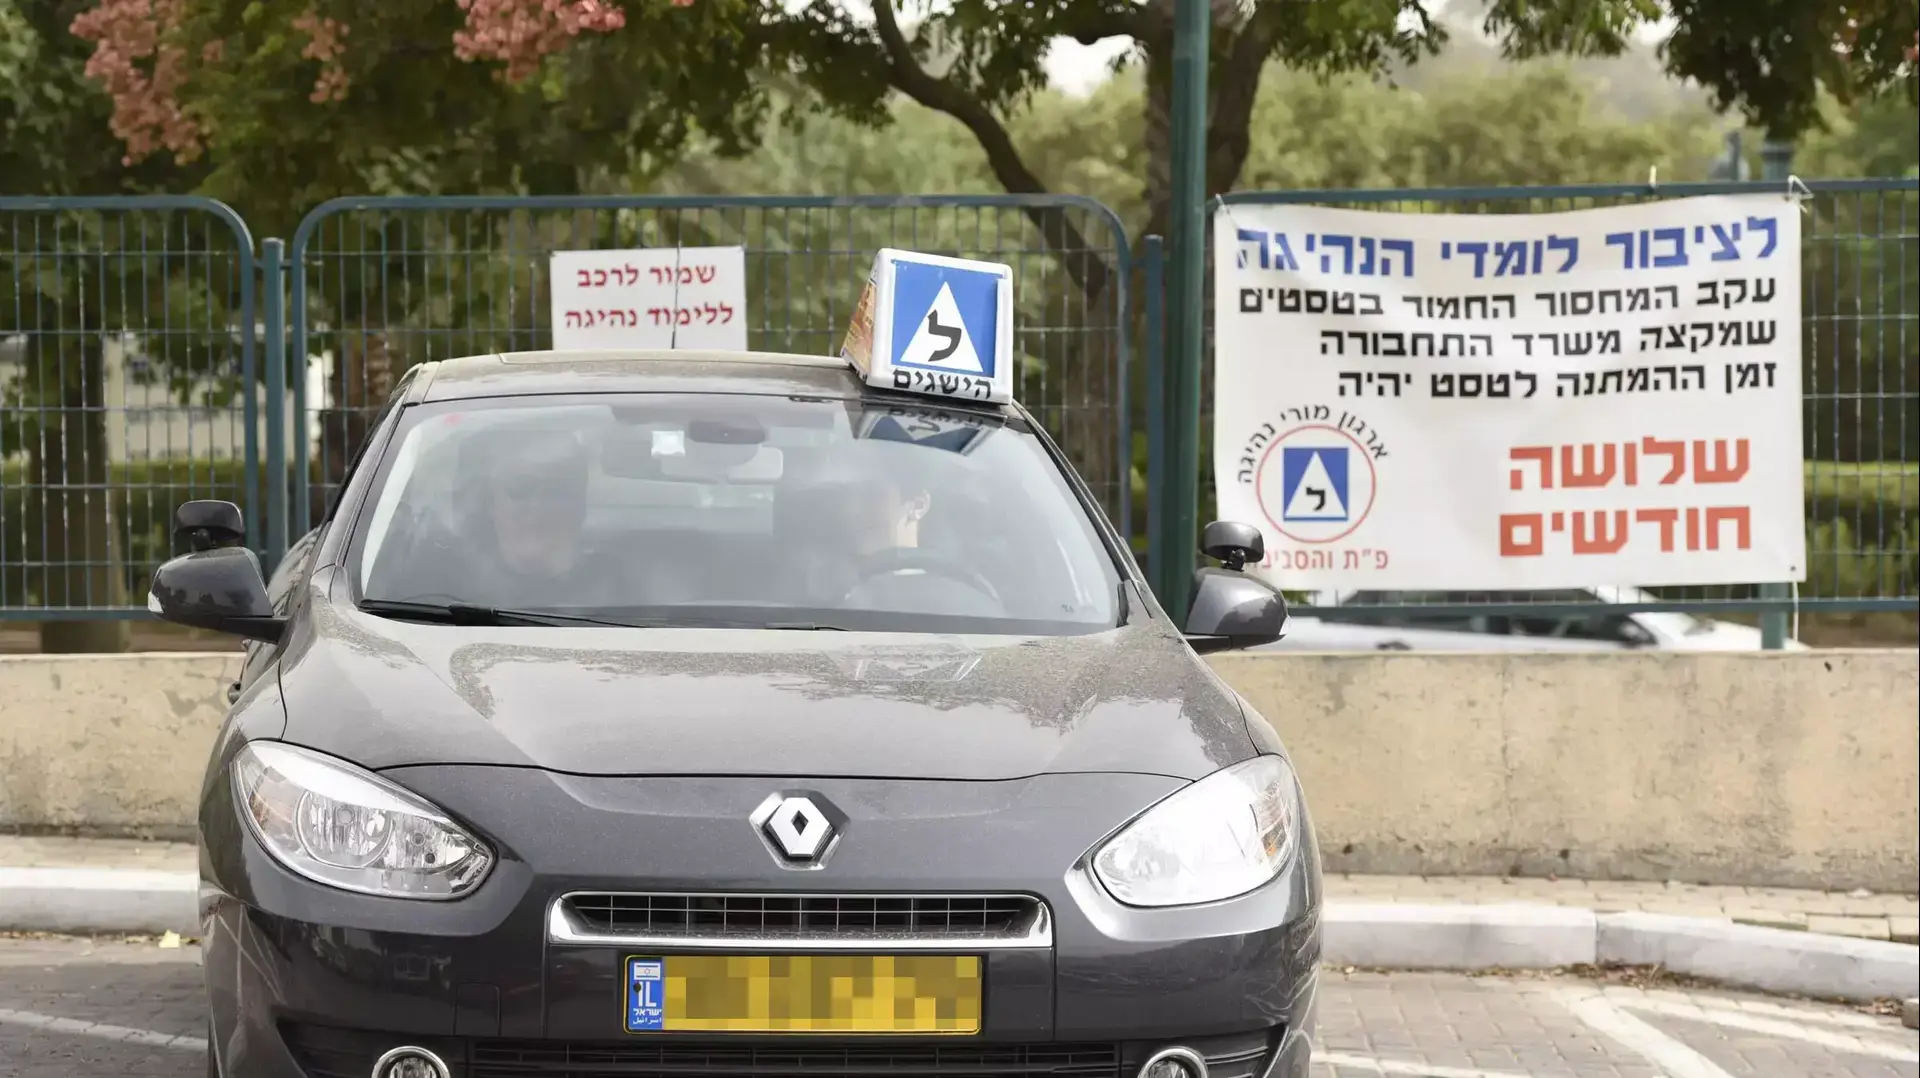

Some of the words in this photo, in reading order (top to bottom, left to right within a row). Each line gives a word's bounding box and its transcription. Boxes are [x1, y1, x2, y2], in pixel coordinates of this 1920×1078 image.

[1237, 228, 1414, 278] הנהיגה
[1441, 235, 1578, 277] לומדי
[1606, 217, 1777, 269] לציבור
[577, 263, 639, 287] לרכב
[649, 264, 716, 284] שמור
[1240, 289, 1384, 316] בטסטים
[1402, 292, 1516, 319] החמור
[1536, 286, 1678, 317] המחסור
[1697, 277, 1775, 307] עקב
[565, 309, 637, 329] נהיגה
[647, 302, 733, 326] ללימוד
[927, 309, 962, 362] ל
[1320, 330, 1493, 356] התחבורה
[1512, 331, 1620, 356] משרד
[1640, 319, 1776, 352] שמקצה
[893, 369, 991, 399] הישגים
[1338, 372, 1412, 397] יהיה
[1431, 371, 1537, 397] לטסט
[1556, 368, 1705, 398] ההמתנה
[1725, 364, 1776, 394] זמן
[1280, 405, 1330, 421] מורי
[1337, 412, 1388, 460] ארגון
[1238, 423, 1276, 483] נהיגה
[1509, 436, 1750, 490] שלושה
[1306, 487, 1325, 511] ל
[1499, 505, 1751, 557] חודשים
[1248, 549, 1333, 569] והסביב
[638, 981, 657, 1007] IL
[633, 1008, 662, 1016] ישראל
